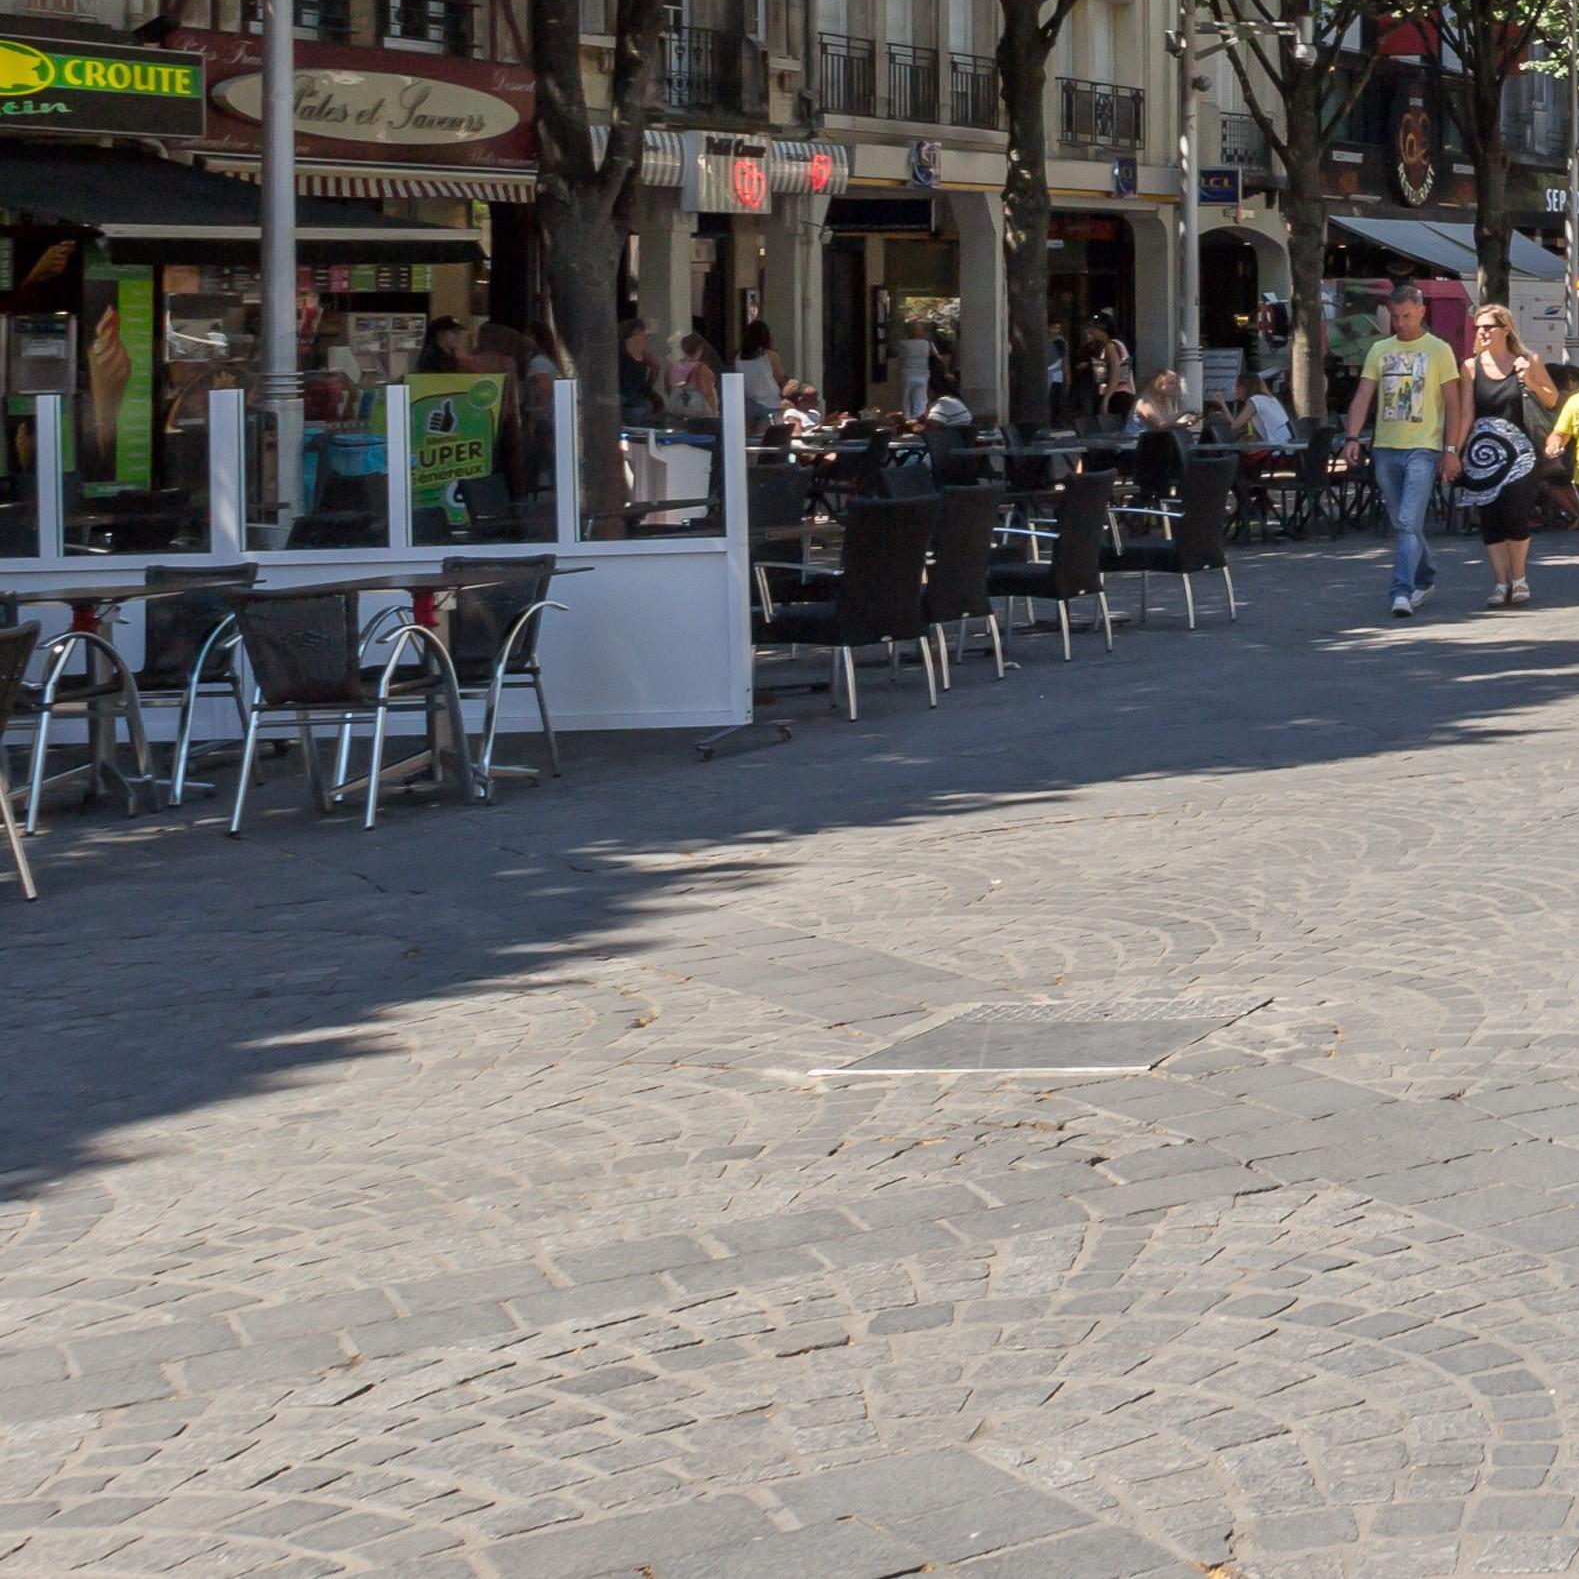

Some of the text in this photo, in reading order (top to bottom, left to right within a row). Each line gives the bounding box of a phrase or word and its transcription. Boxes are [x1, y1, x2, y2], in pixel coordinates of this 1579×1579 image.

[64, 59, 191, 94] CROUTE
[355, 98, 385, 125] et
[412, 441, 482, 469] UPER
